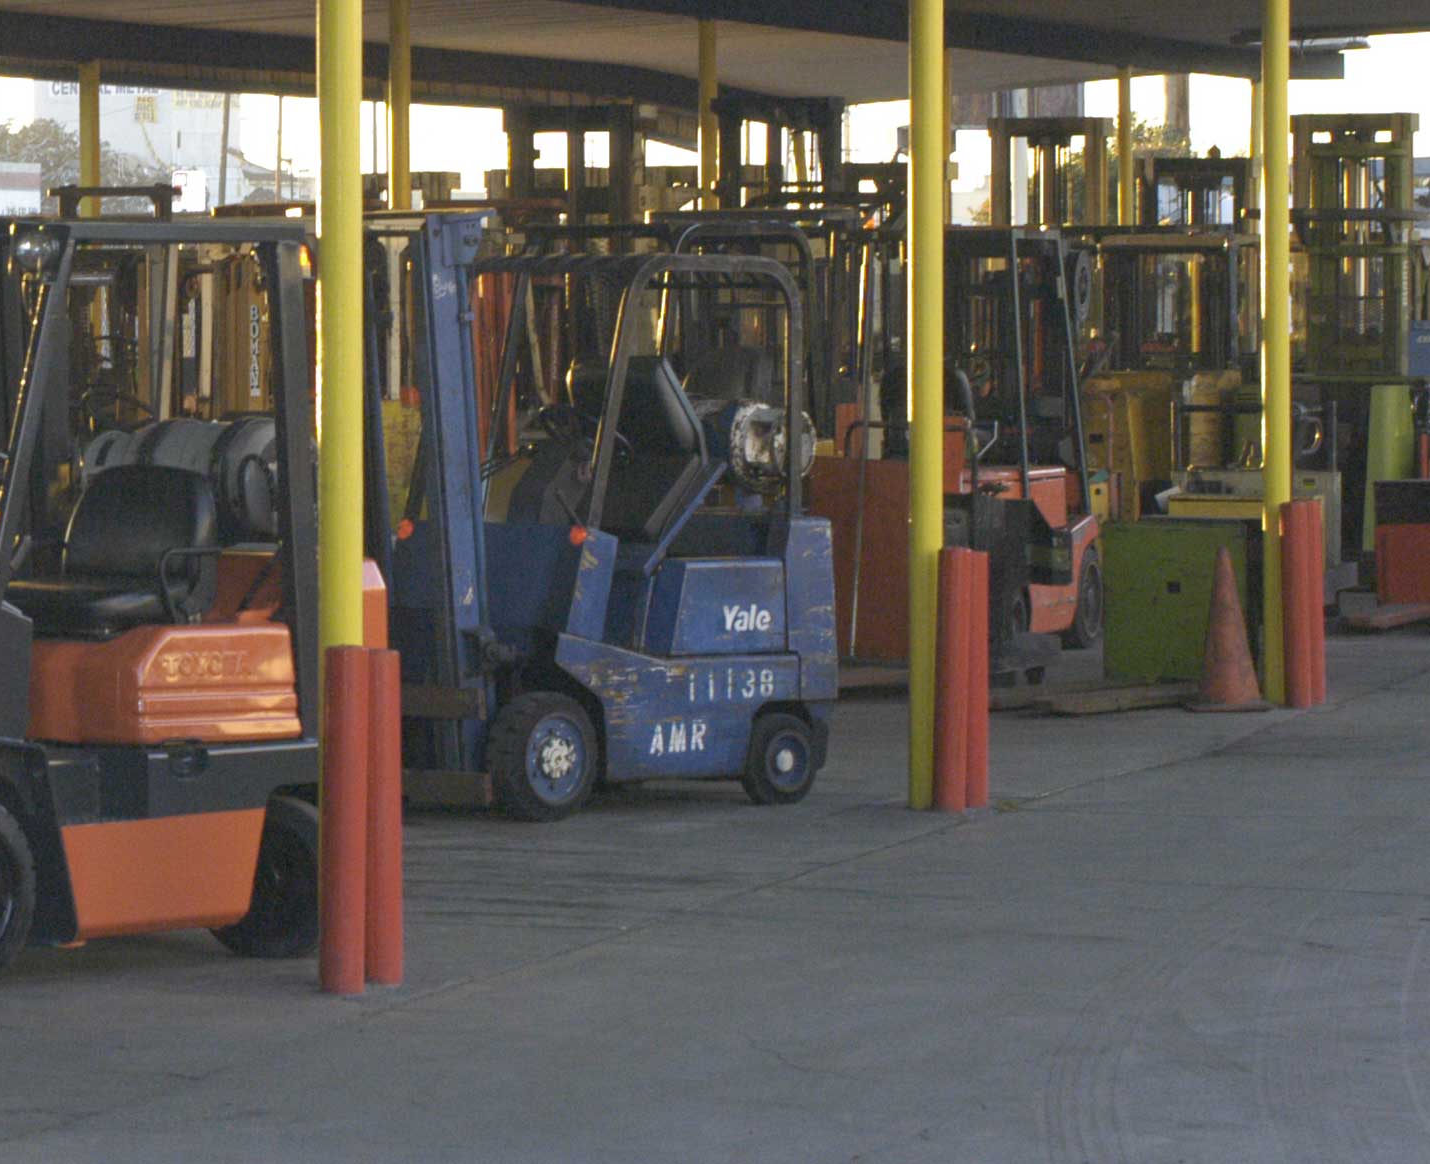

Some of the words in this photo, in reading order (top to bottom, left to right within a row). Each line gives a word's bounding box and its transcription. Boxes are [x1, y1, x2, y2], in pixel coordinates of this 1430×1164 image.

[52, 80, 112, 95] CENL
[722, 604, 772, 632] Yale
[162, 650, 259, 681] TOYOTA
[689, 668, 774, 702] 11138
[650, 721, 707, 756] AMR
